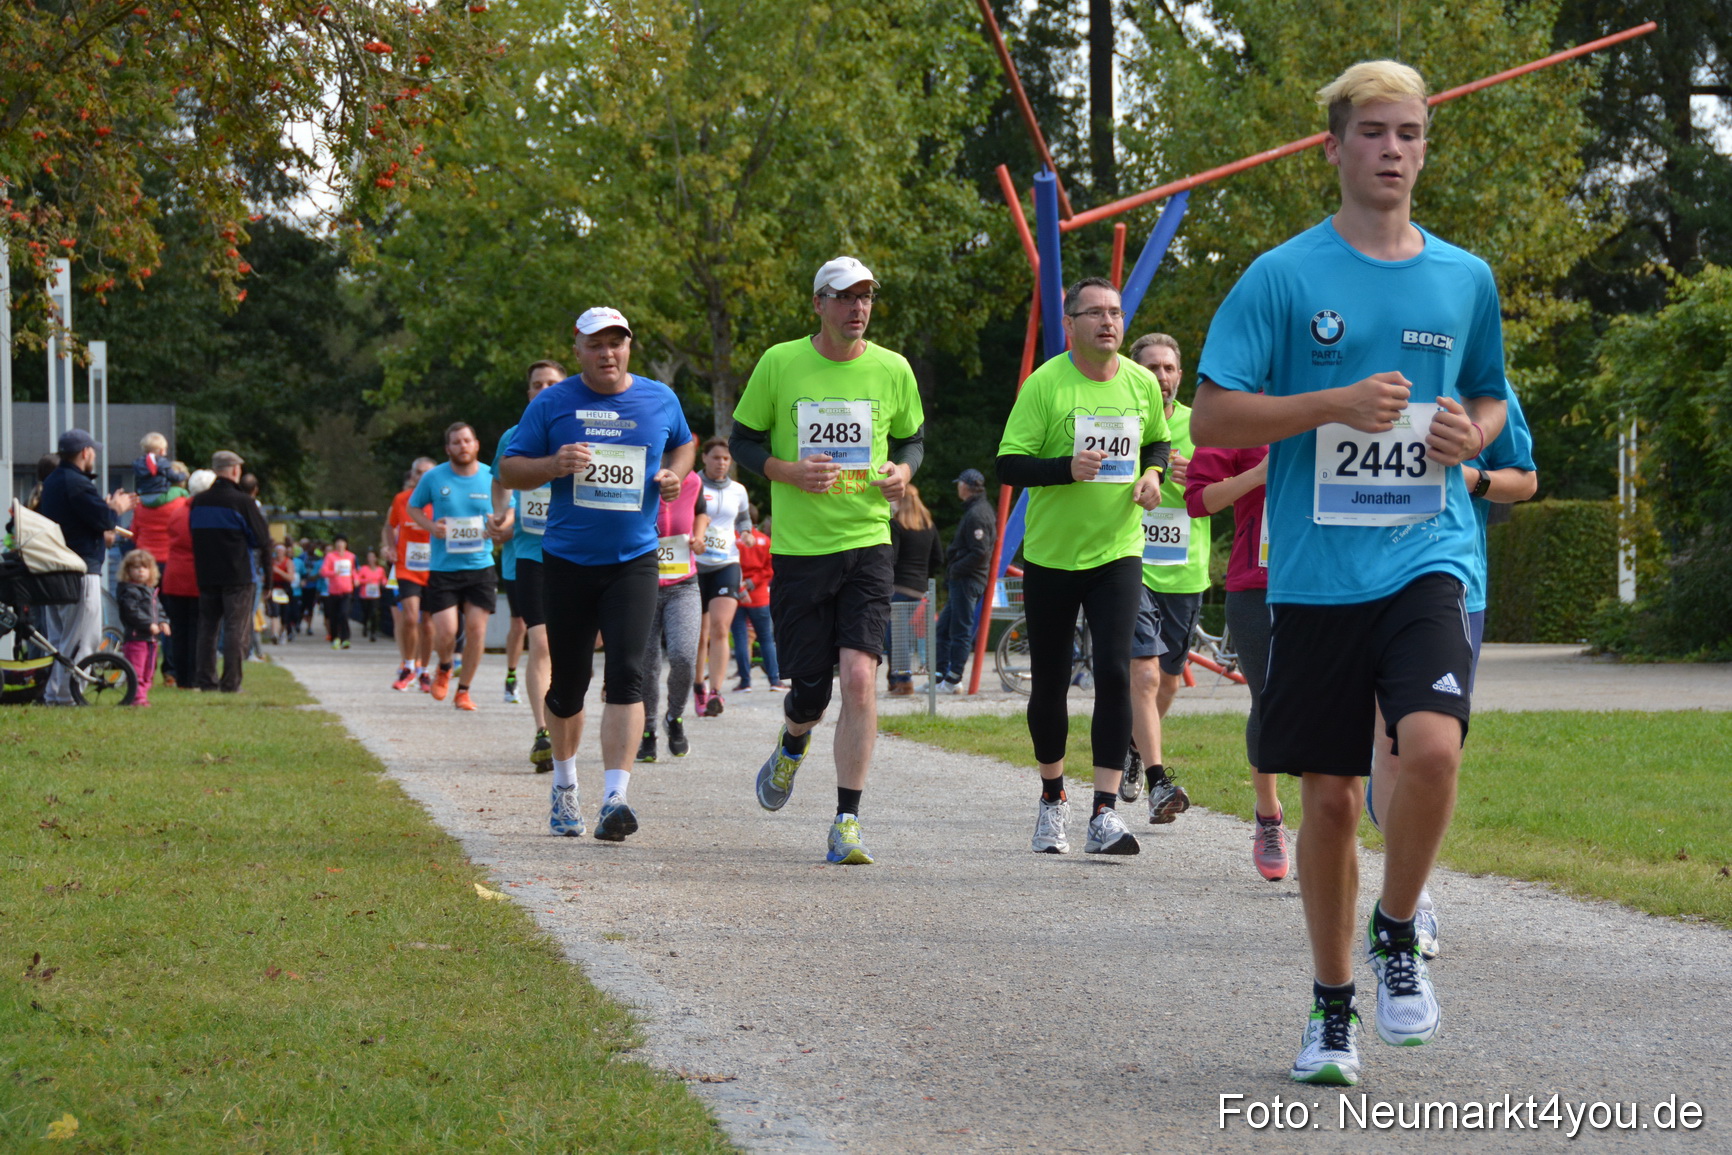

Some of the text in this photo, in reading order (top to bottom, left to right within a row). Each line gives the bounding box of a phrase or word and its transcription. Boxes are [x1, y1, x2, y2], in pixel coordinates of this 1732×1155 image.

[1313, 311, 1342, 323] BMW
[1402, 330, 1454, 350] BOCK
[1311, 350, 1343, 359] PARTL
[586, 411, 612, 419] HEUTE
[594, 419, 631, 428] MORGEN
[585, 427, 622, 437] BEWEGEN
[809, 422, 861, 443] 2483
[1085, 436, 1131, 457] 2140
[823, 449, 848, 458] Stefan
[1335, 441, 1427, 478] 2443
[584, 463, 634, 485] 2398
[1322, 471, 1328, 479] D
[594, 489, 622, 498] Michael
[1351, 491, 1411, 505] Jonathan
[451, 528, 479, 539] 2403
